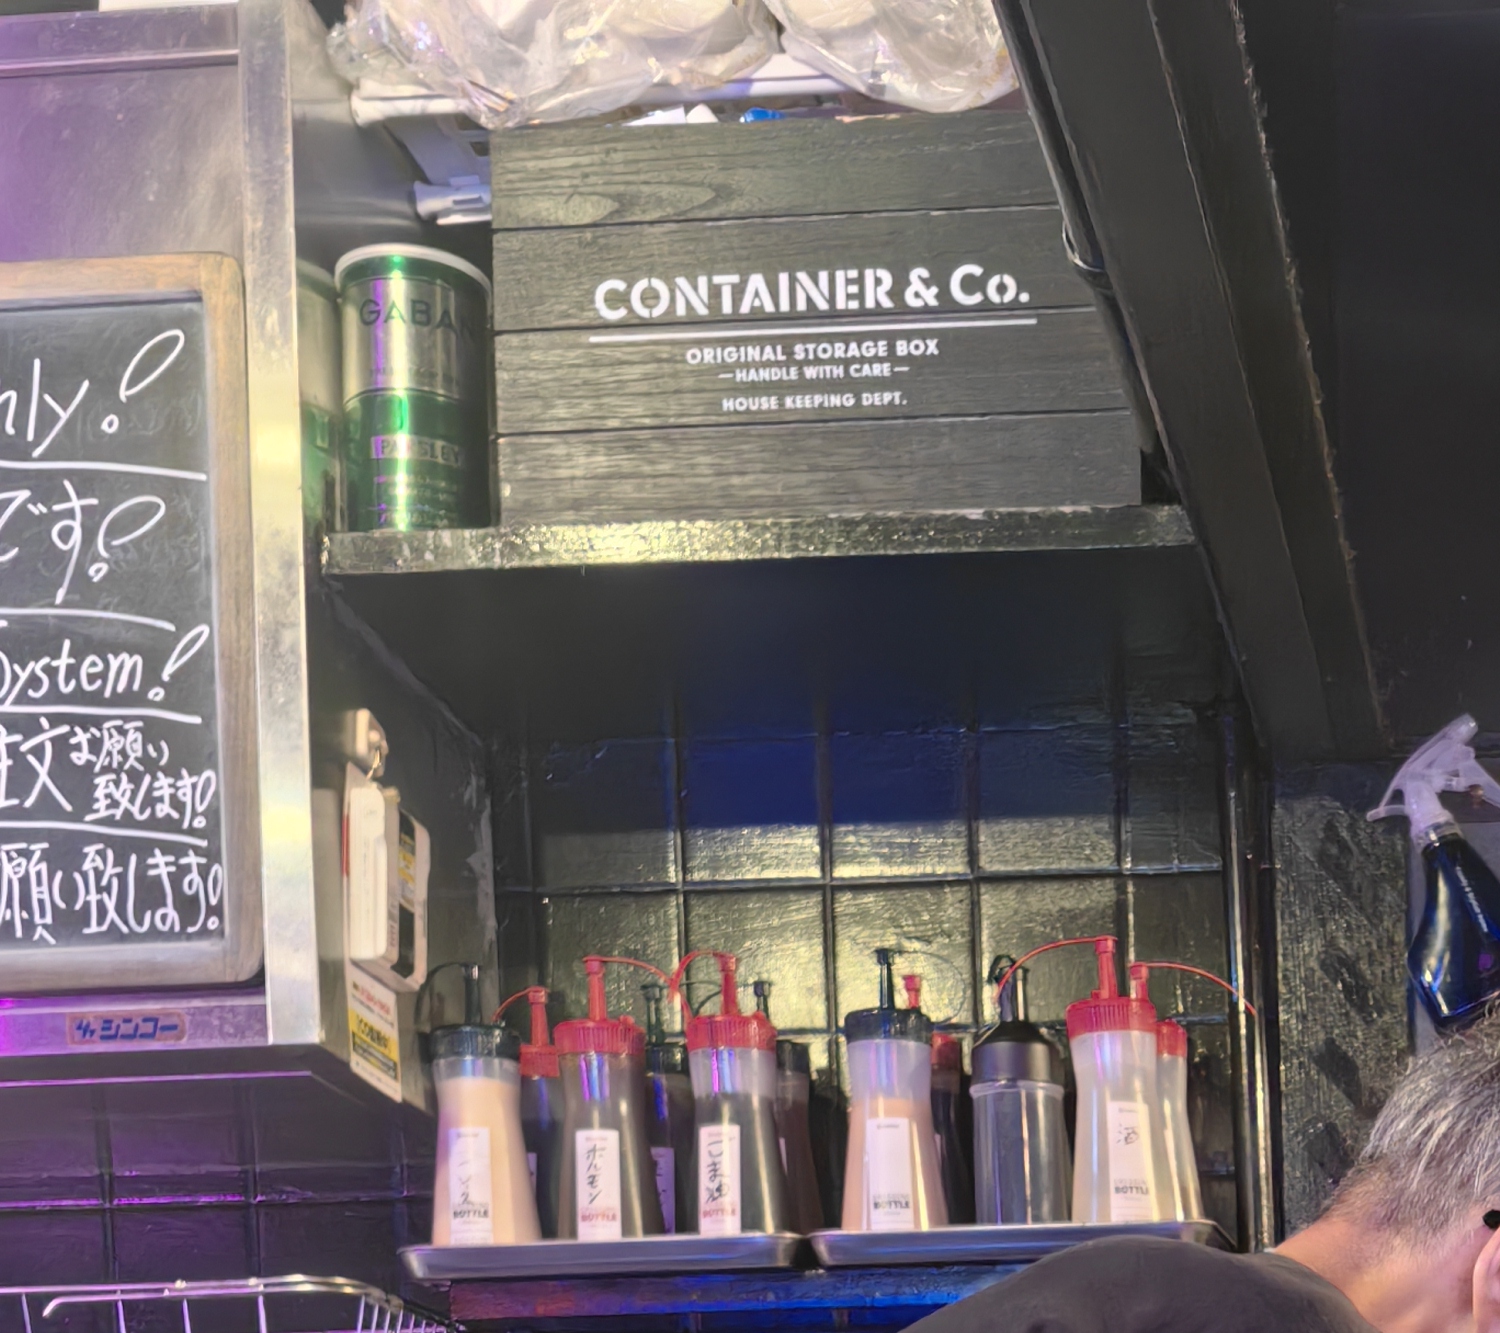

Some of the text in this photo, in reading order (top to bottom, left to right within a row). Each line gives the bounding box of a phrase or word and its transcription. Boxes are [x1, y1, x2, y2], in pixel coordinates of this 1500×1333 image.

[594, 263, 1031, 320] CONTAINER & Co.
[686, 338, 940, 365] ORIGINAL STORAGE BOX
[803, 364, 845, 380] WITH
[722, 390, 908, 412] HOUSE KEEPING DEPT.
[381, 437, 461, 467] PSLEY
[702, 1207, 737, 1219] BOTTE
